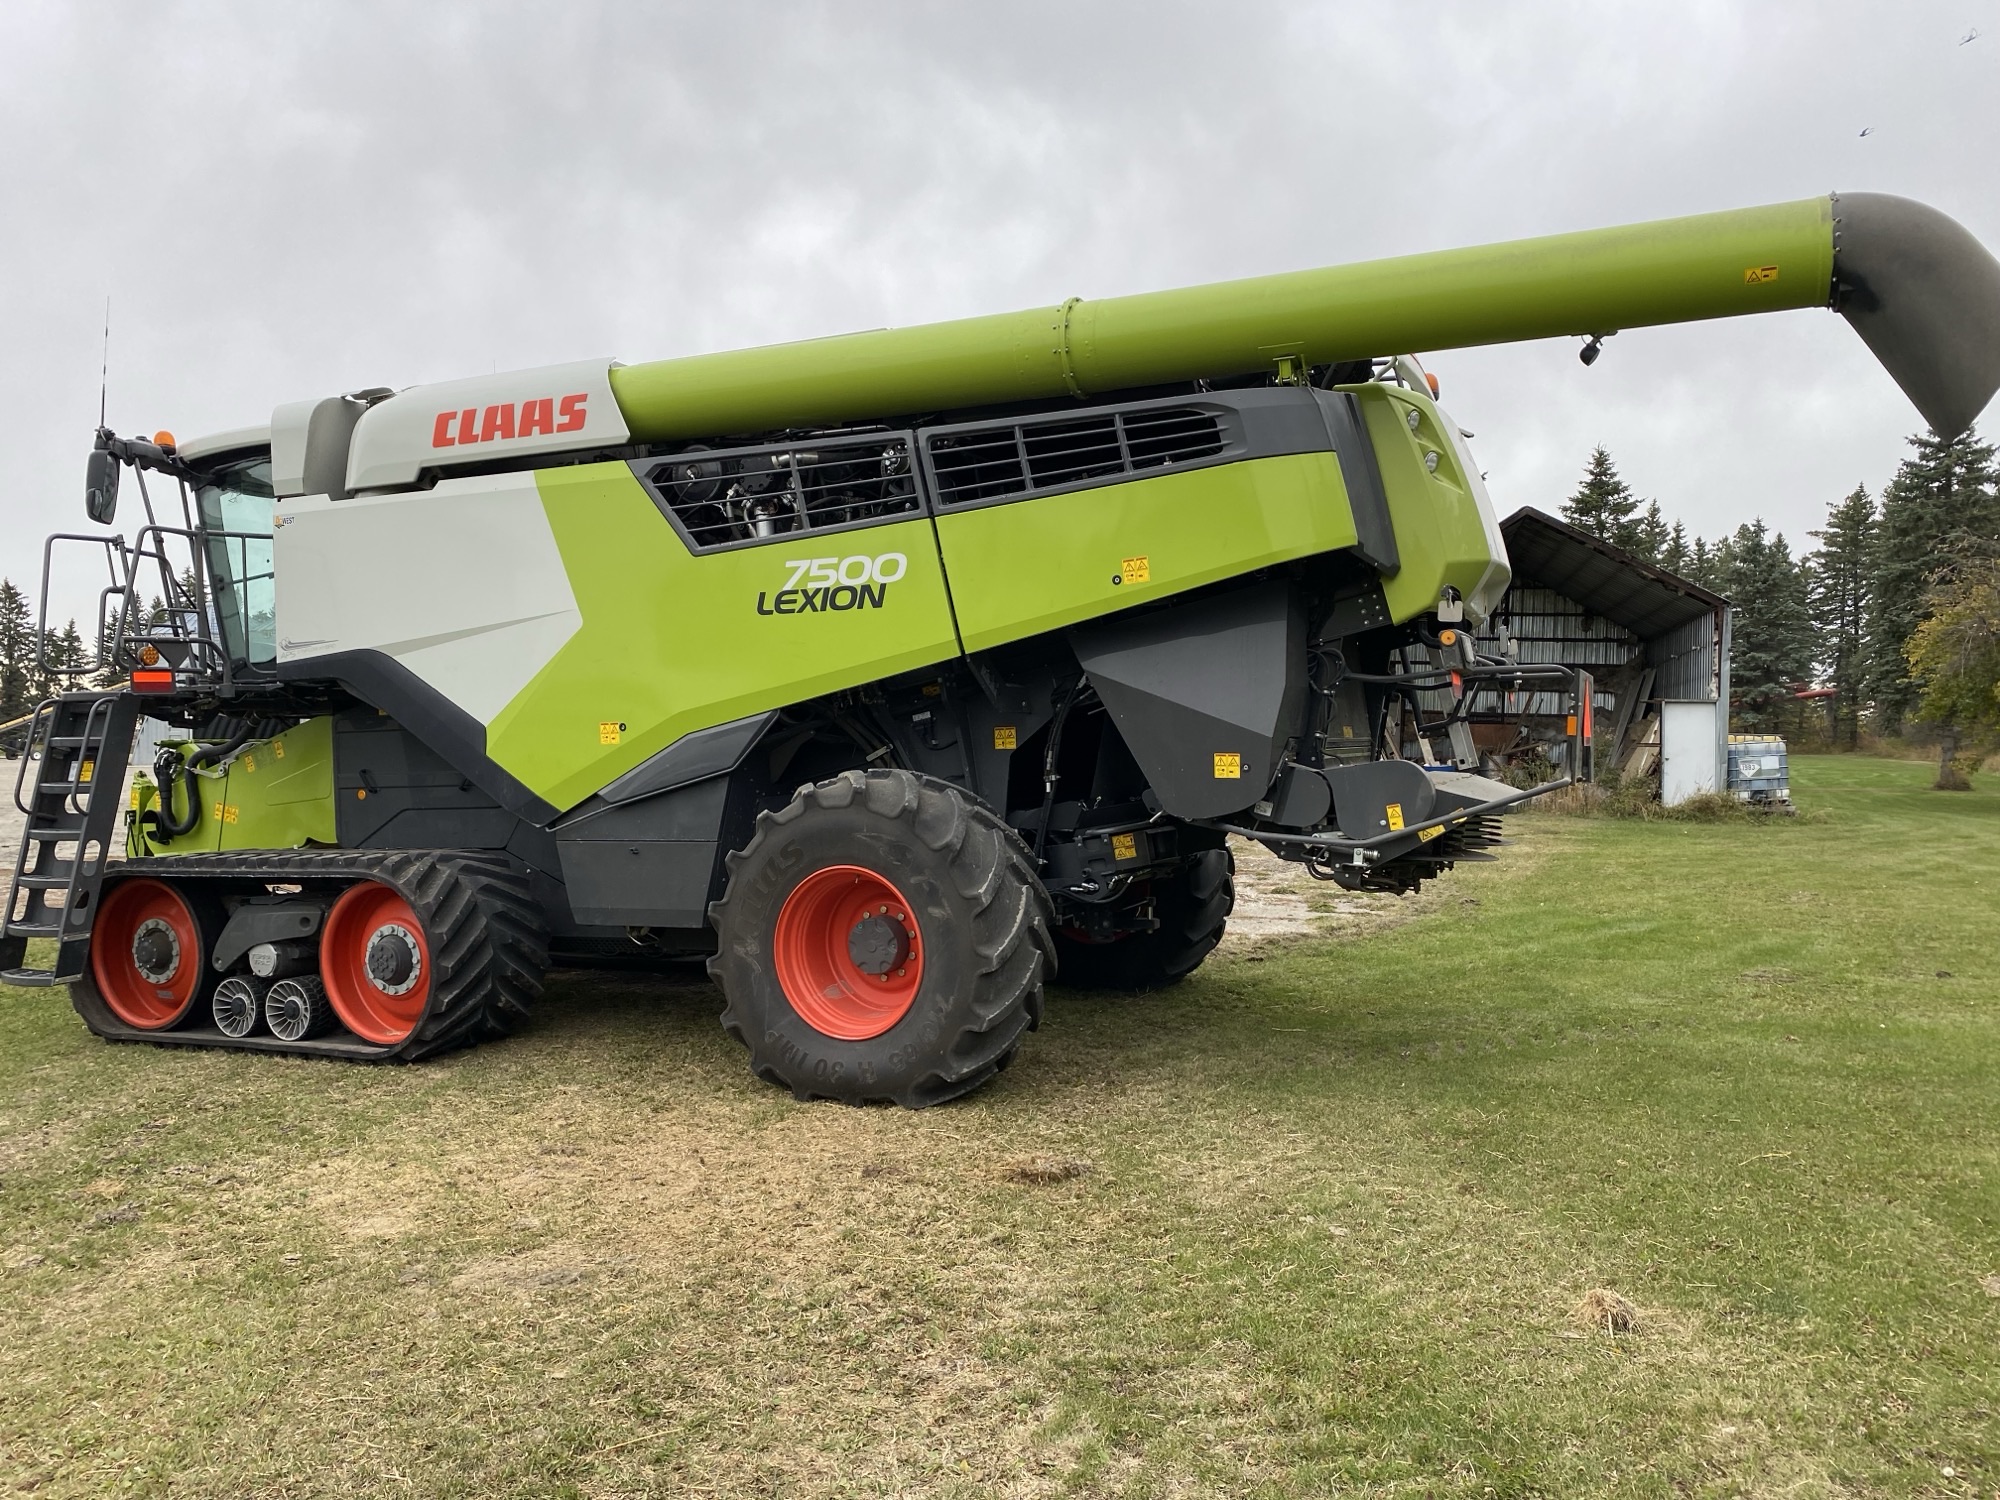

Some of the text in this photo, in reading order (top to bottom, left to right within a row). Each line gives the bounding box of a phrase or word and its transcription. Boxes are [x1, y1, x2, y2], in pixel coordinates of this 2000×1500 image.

[432, 393, 588, 448] CLAAS
[783, 552, 908, 590] 7500
[756, 582, 887, 616] LEXION
[813, 1058, 845, 1083] 30
